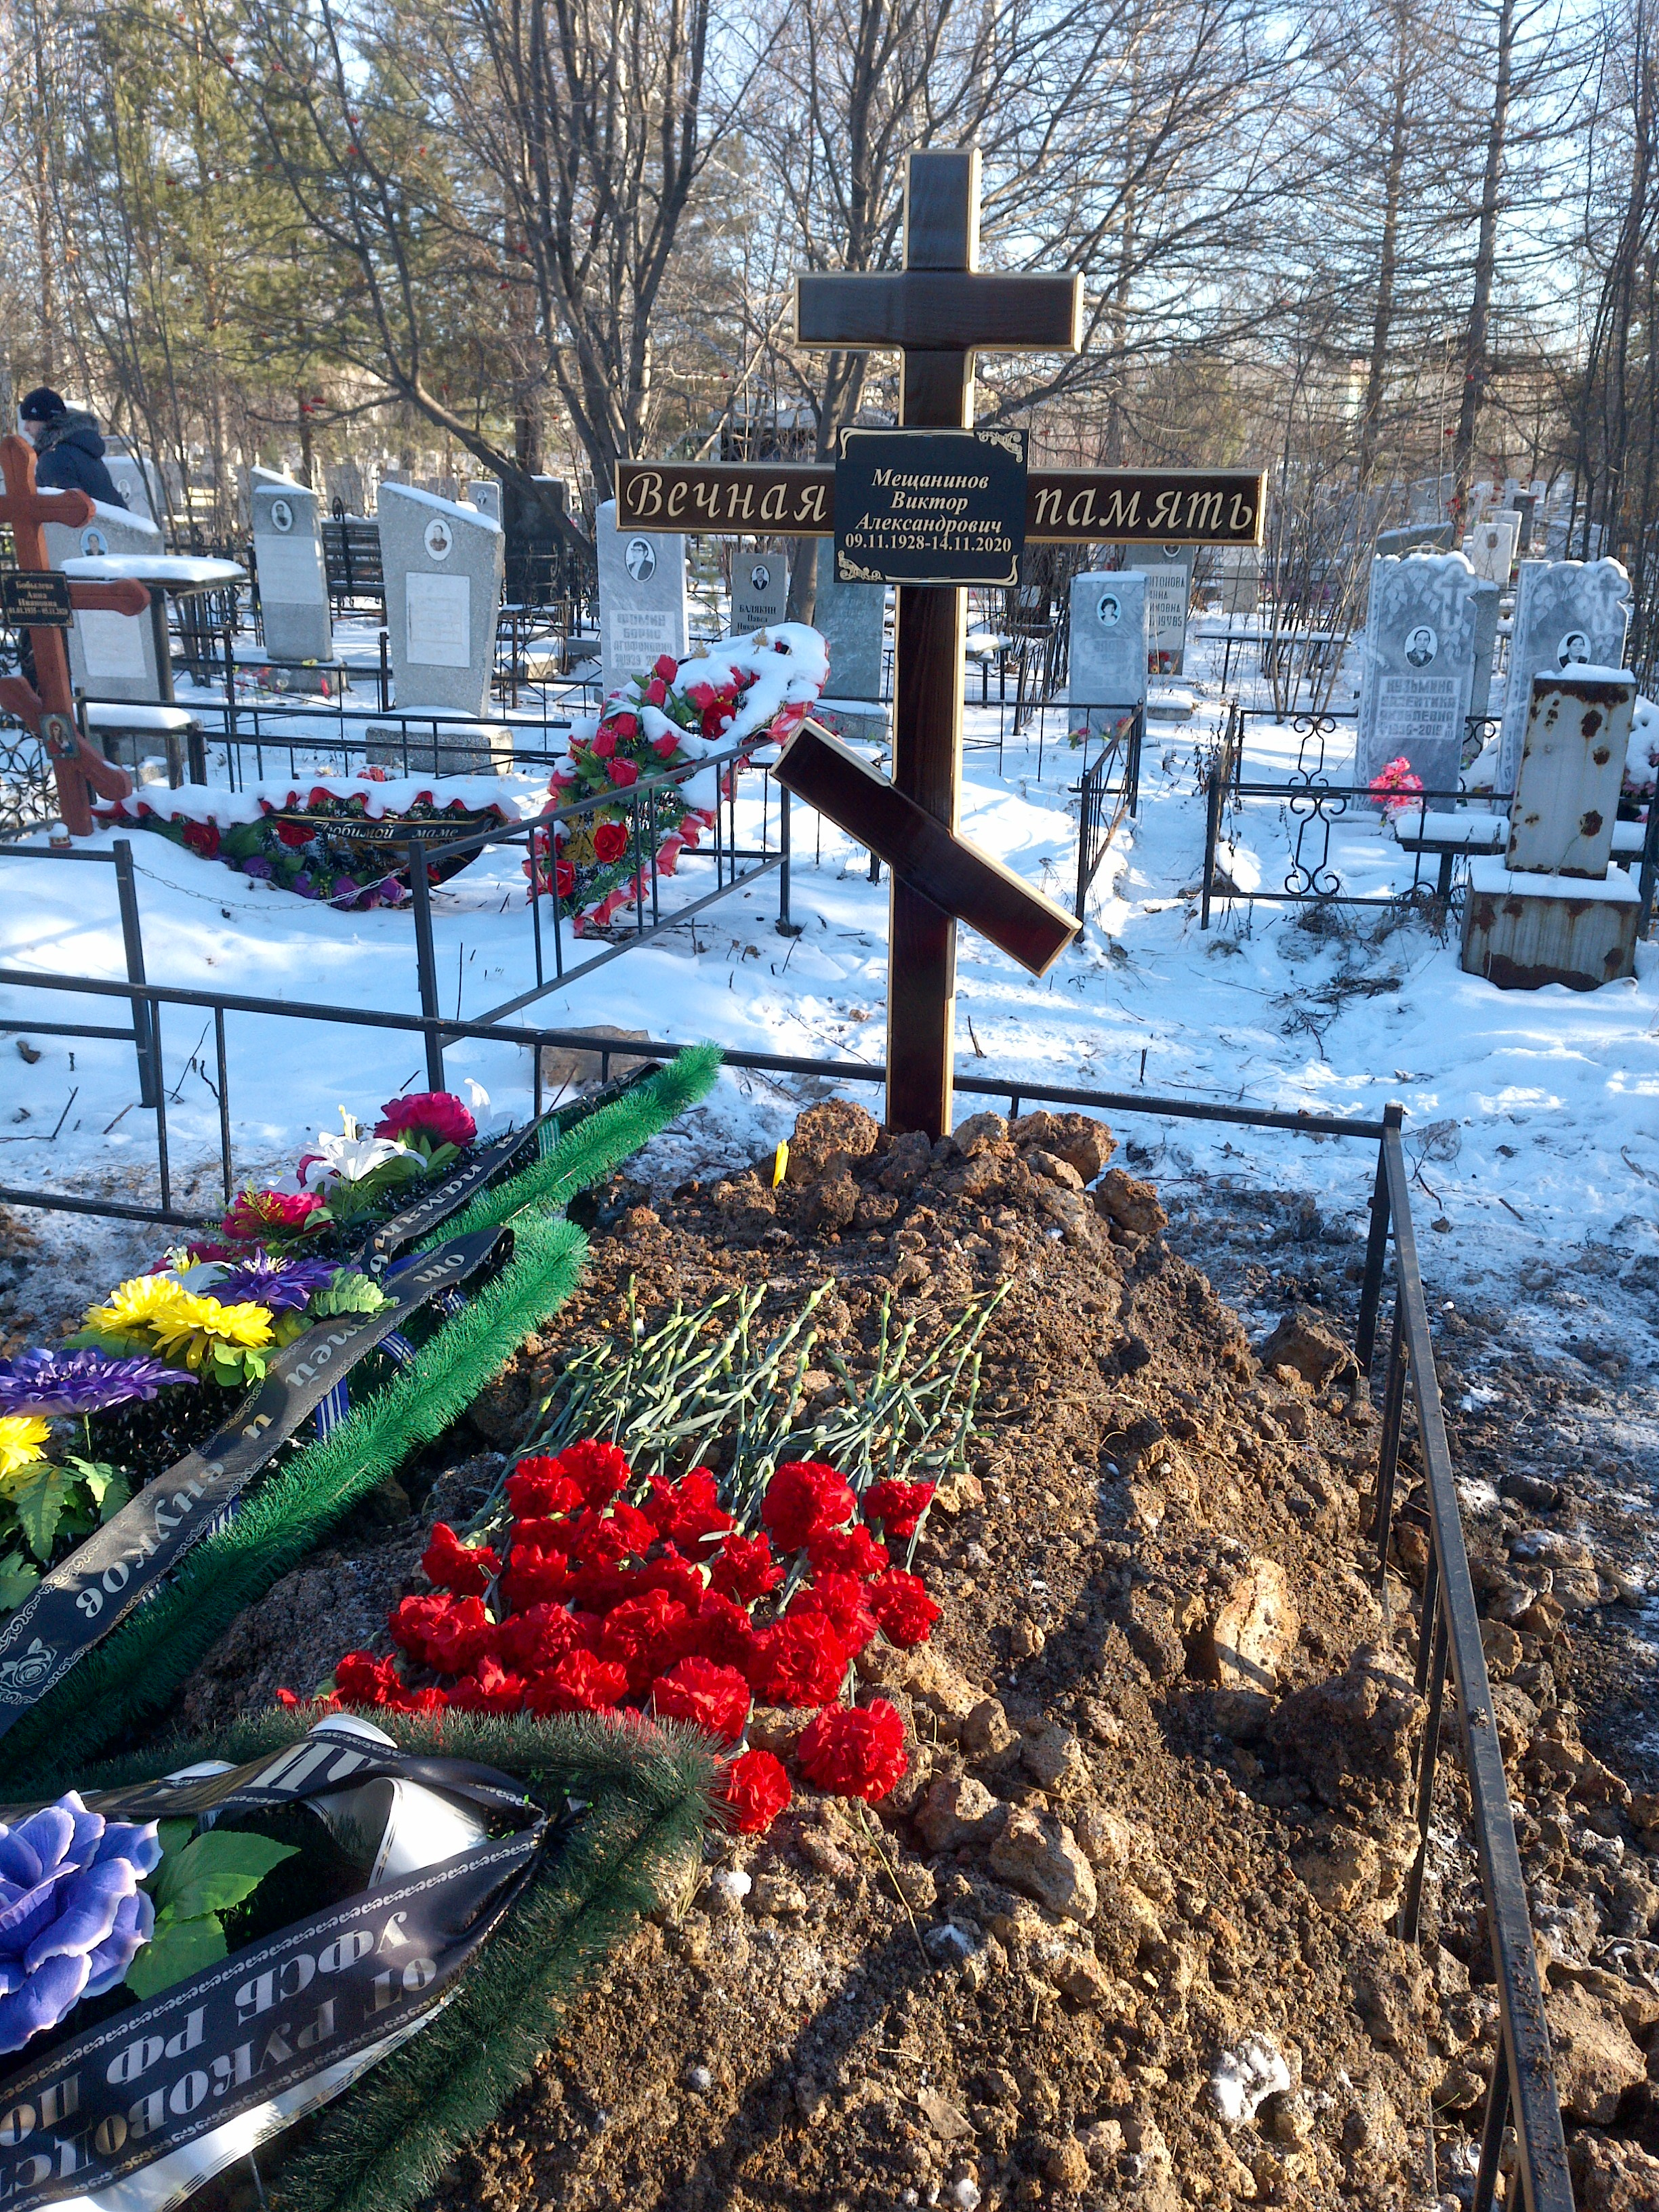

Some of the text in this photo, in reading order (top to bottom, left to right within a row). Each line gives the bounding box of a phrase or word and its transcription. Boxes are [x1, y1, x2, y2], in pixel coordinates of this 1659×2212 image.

[871, 468, 990, 491] Мещанинов
[626, 471, 1254, 530] Вечная память
[889, 491, 969, 515] Виктор
[855, 512, 1002, 536] Александрович
[844, 533, 1012, 552] 09.11.1928-14.11.2020
[739, 604, 777, 615] БАЛЯКИН
[623, 627, 661, 640] БОРИС
[411, 827, 459, 839] маме
[369, 1164, 484, 1273] память
[413, 1254, 465, 1284] от
[242, 1413, 274, 1439] и
[75, 1462, 224, 1618] внуков
[234, 1910, 411, 2027] УФСБ
[106, 2003, 209, 2086] РФ
[0, 1958, 437, 2200] ОТ РУКОВОДС
